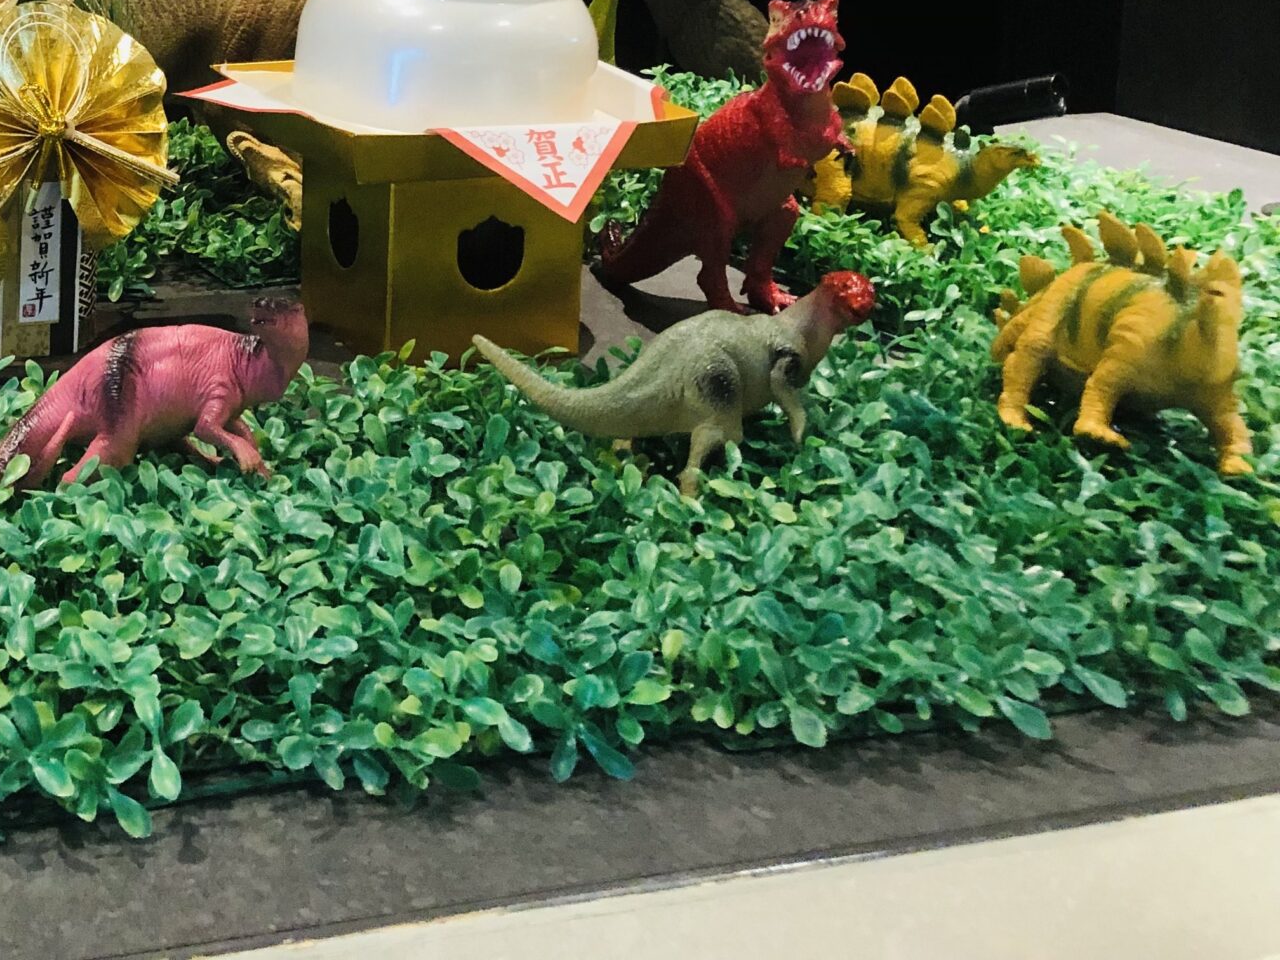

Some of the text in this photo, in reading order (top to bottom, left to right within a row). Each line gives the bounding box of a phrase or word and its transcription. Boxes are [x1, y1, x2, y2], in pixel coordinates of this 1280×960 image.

[525, 129, 577, 189] 賀正
[27, 205, 55, 315] 謹賀新年
